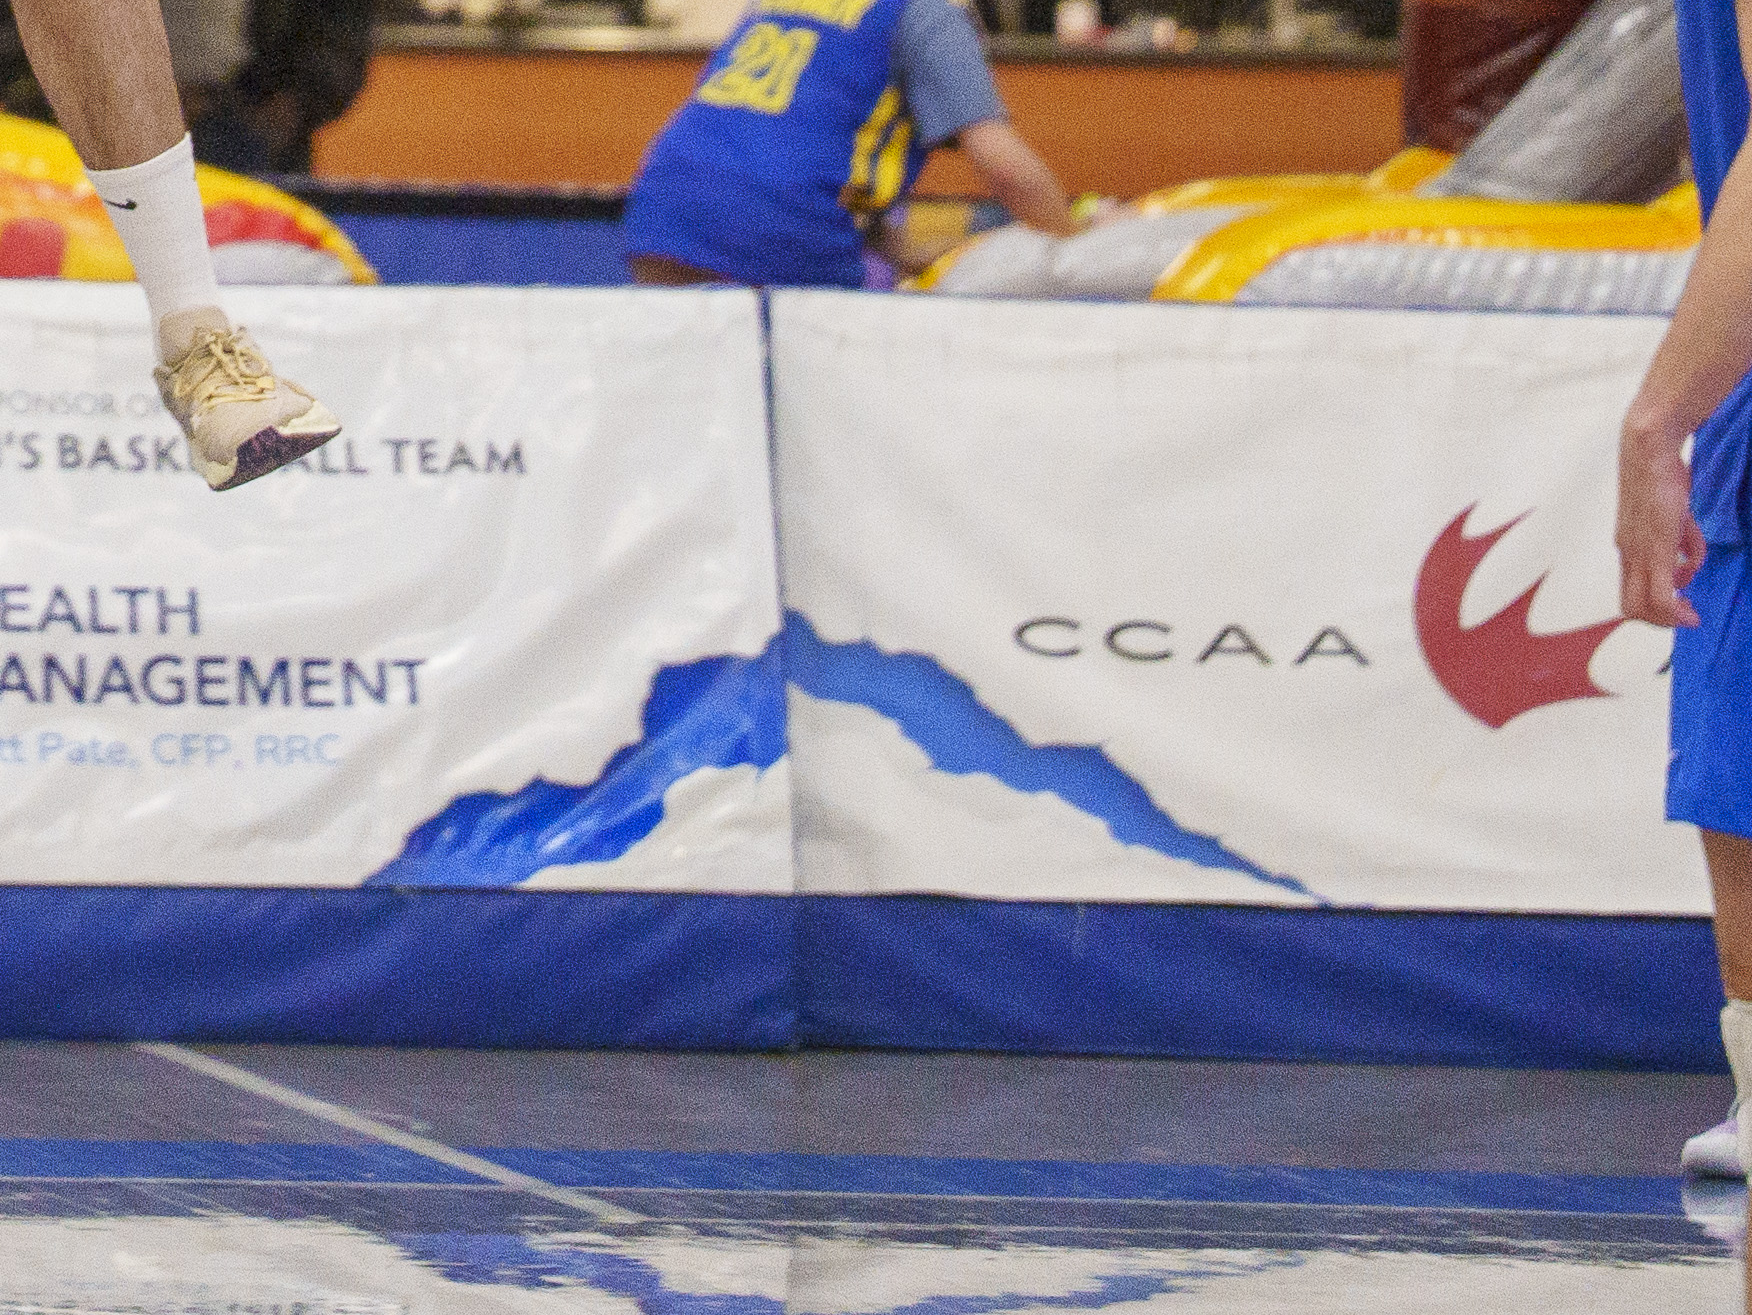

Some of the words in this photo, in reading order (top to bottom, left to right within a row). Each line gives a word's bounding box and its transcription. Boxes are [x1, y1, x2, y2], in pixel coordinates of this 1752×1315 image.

[386, 437, 527, 476] TEAM
[1012, 616, 1372, 669] CCAA
[254, 733, 342, 768] RRC
